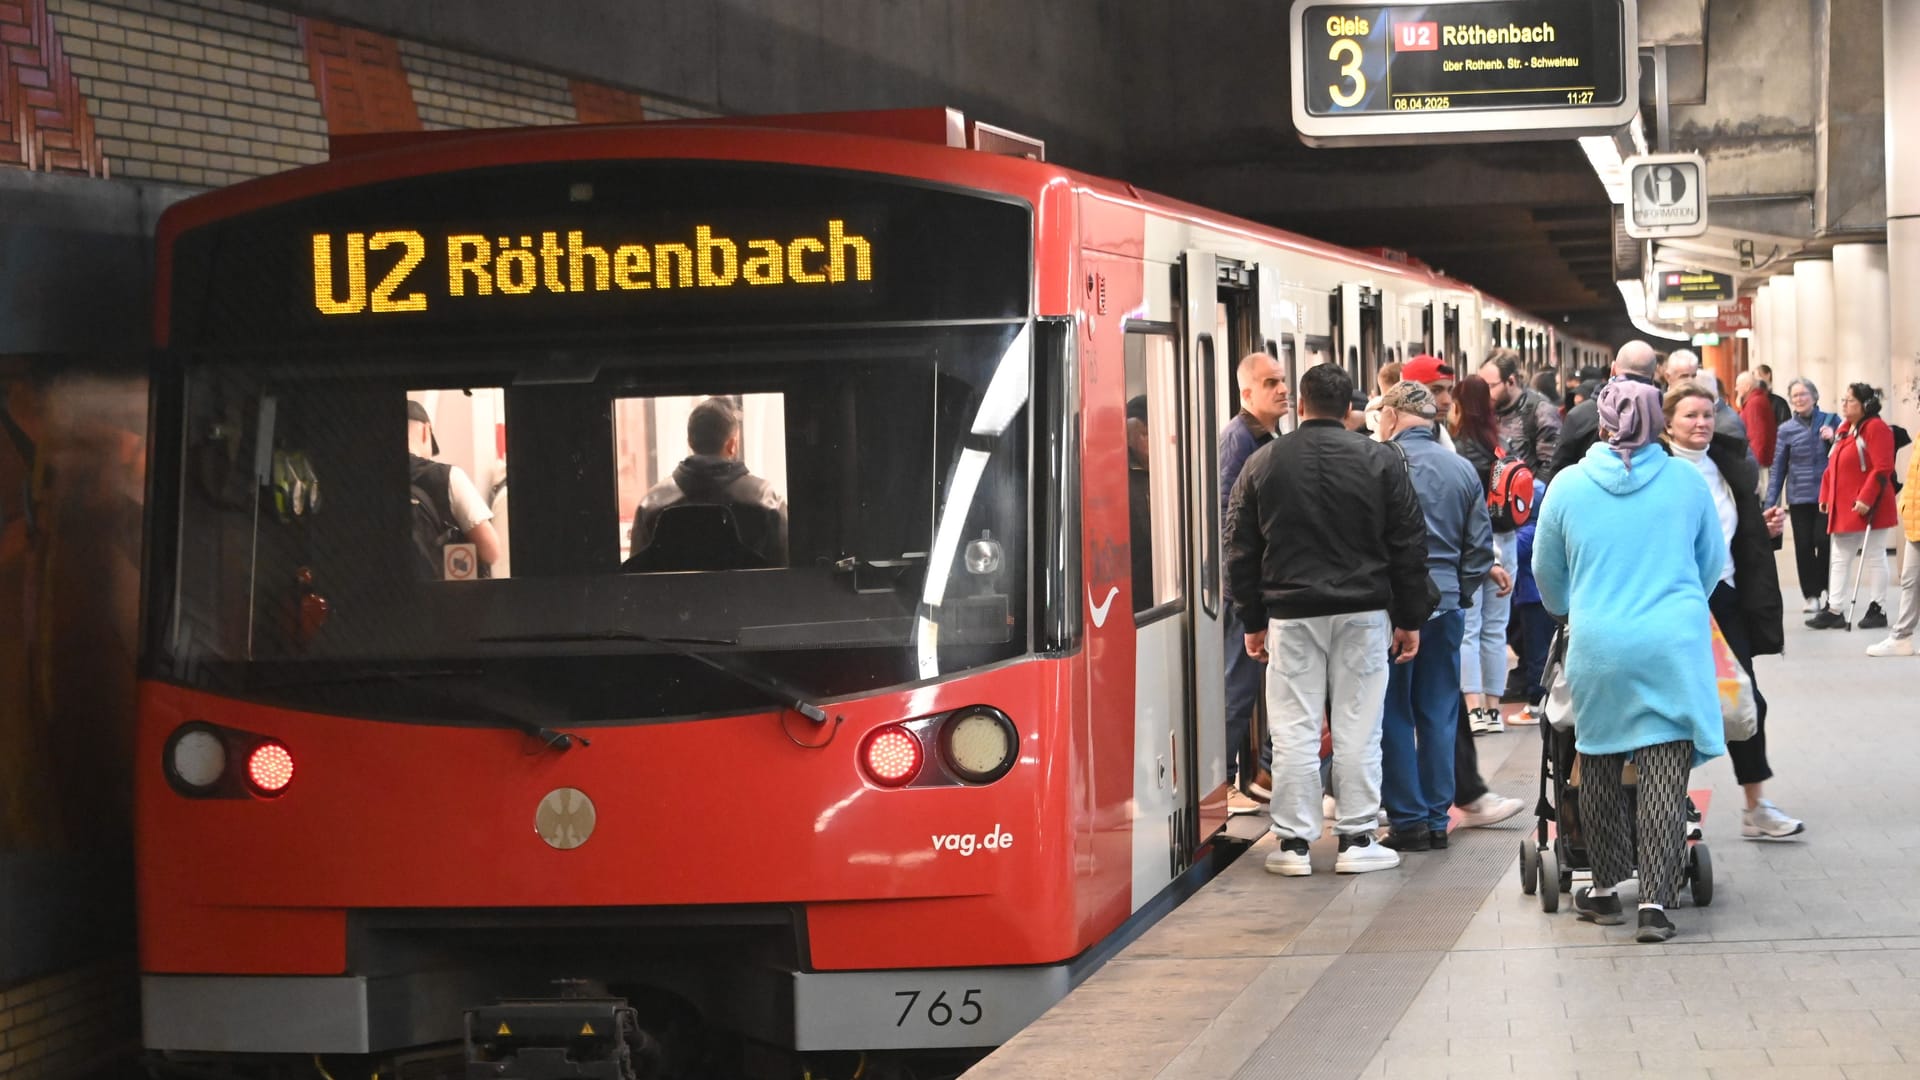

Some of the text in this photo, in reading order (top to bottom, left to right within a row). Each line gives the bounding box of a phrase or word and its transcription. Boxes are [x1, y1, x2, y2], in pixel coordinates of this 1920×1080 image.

[1327, 16, 1369, 36] Gleis
[1402, 22, 1555, 46] U2 Röthenbach
[1329, 38, 1366, 108] 3
[1443, 60, 1463, 72] über
[1465, 58, 1505, 71] Rothenb.
[1507, 57, 1523, 69] Str.
[1531, 56, 1579, 68] Schweinau
[1394, 92, 1594, 111] 08.04.2025 11:27
[1636, 207, 1694, 218] INFORMATION
[312, 219, 872, 315] U2 Röthenbach
[931, 824, 1013, 856] vag.de
[895, 988, 983, 1027] 765
